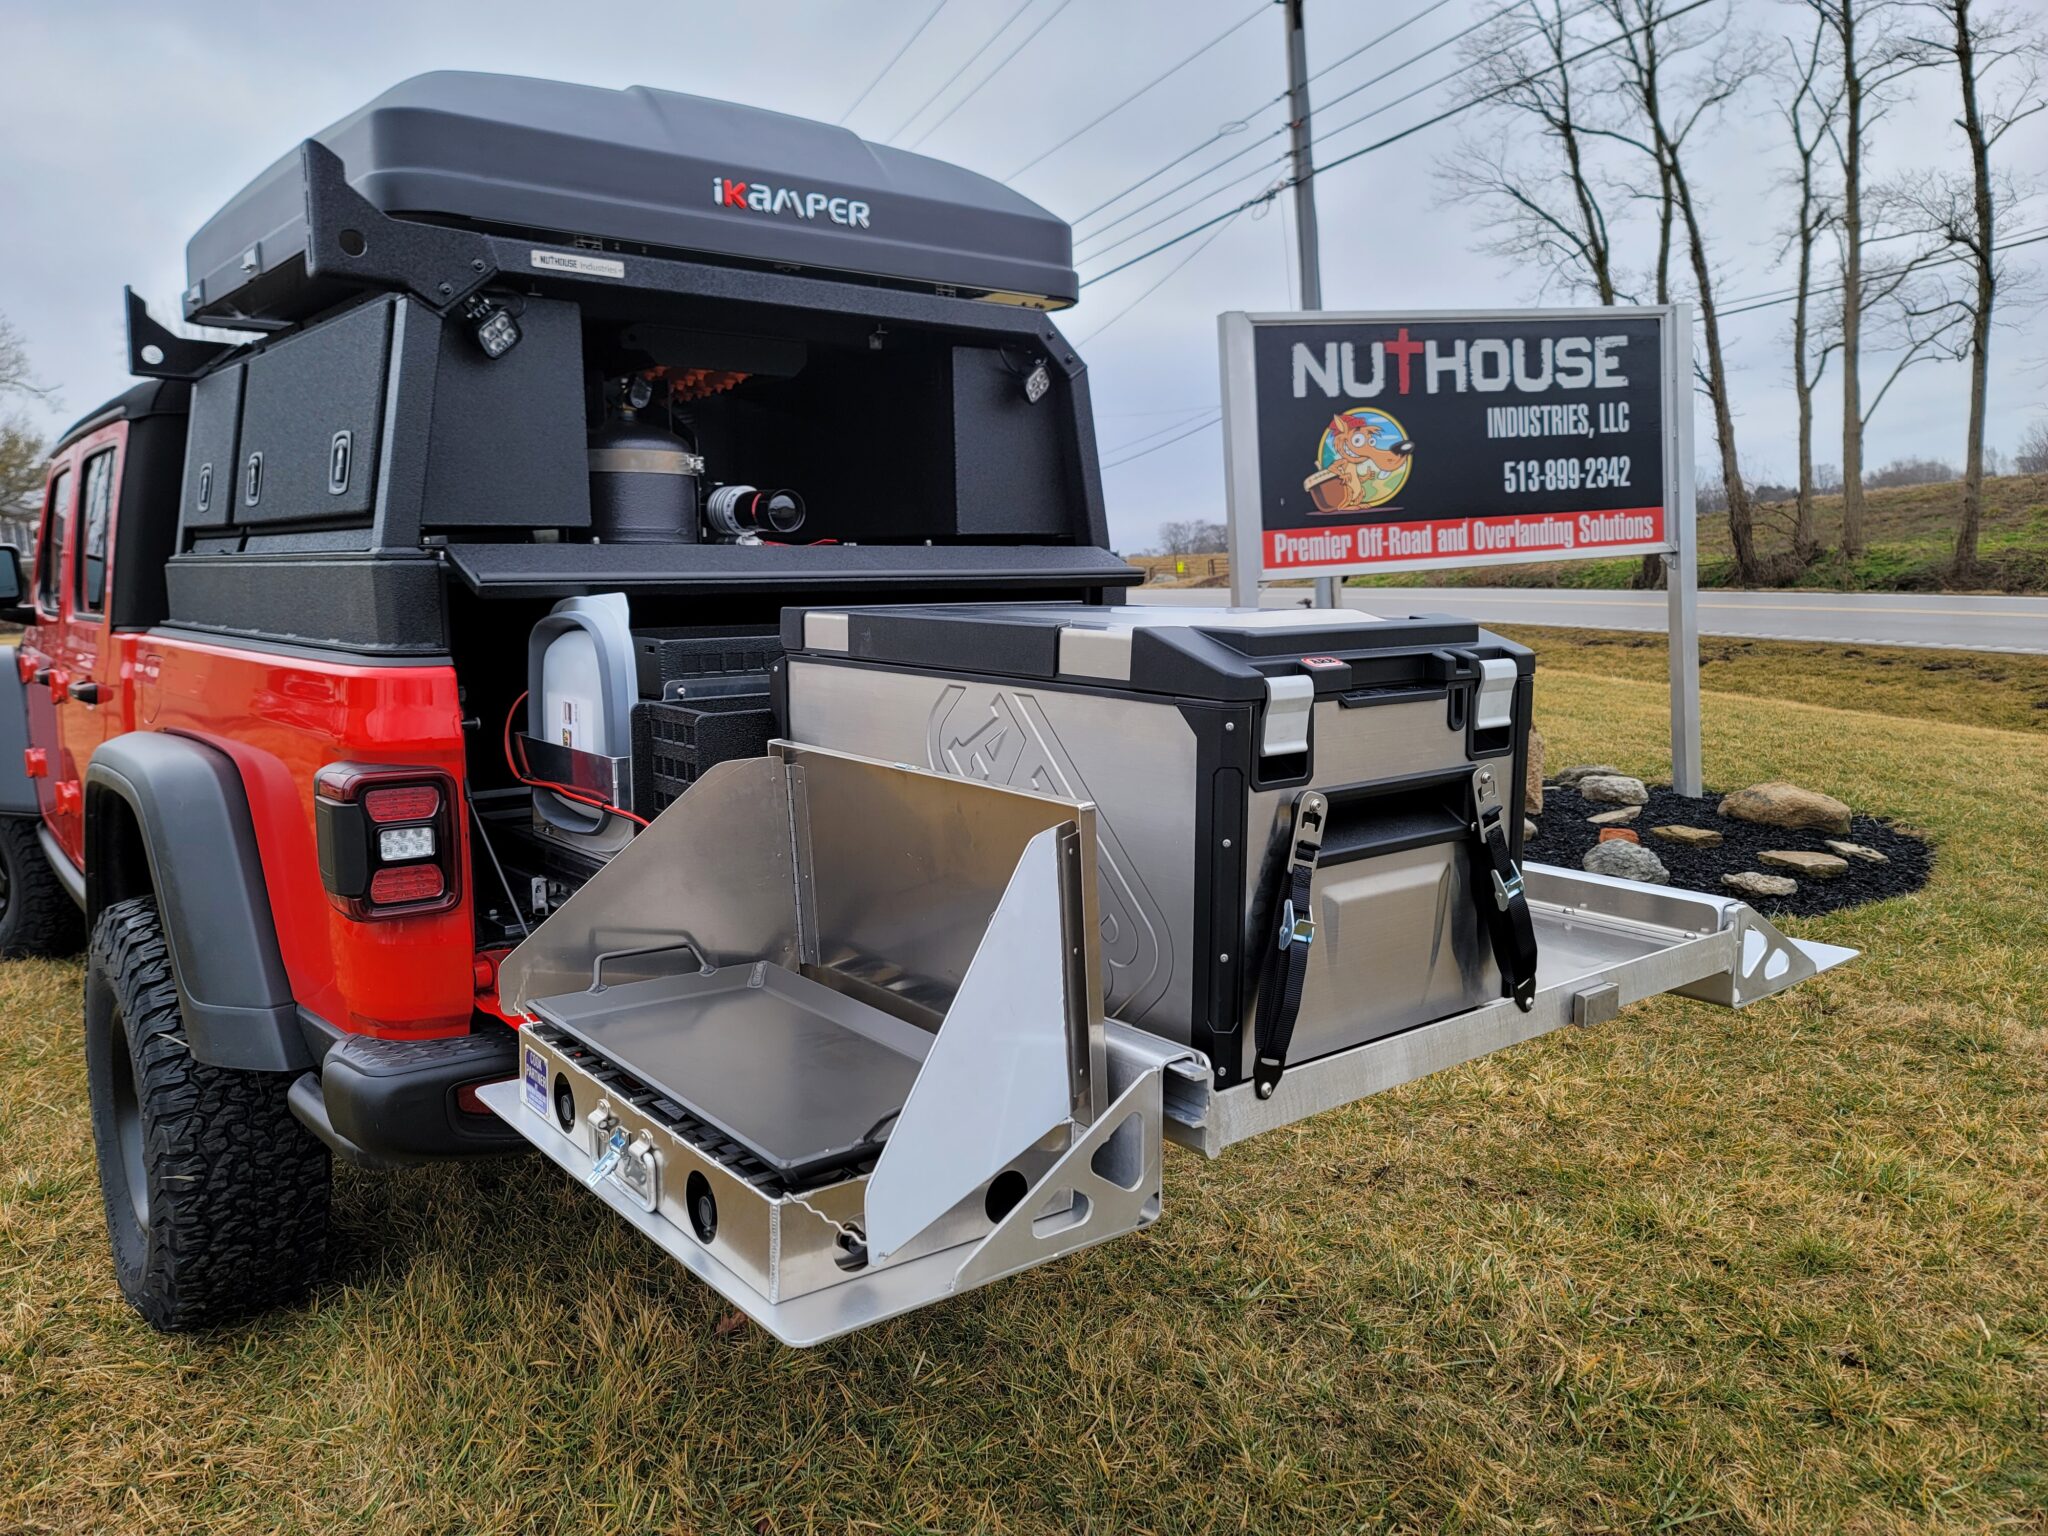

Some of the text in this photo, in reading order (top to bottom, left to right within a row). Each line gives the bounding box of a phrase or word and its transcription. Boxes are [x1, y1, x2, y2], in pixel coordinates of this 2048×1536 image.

[1487, 401, 1630, 439] INDUSTRIES, LLC
[1503, 455, 1631, 493] 513-899-2342
[1274, 512, 1653, 563] Premier Off-Road and Overlanding Solutions
